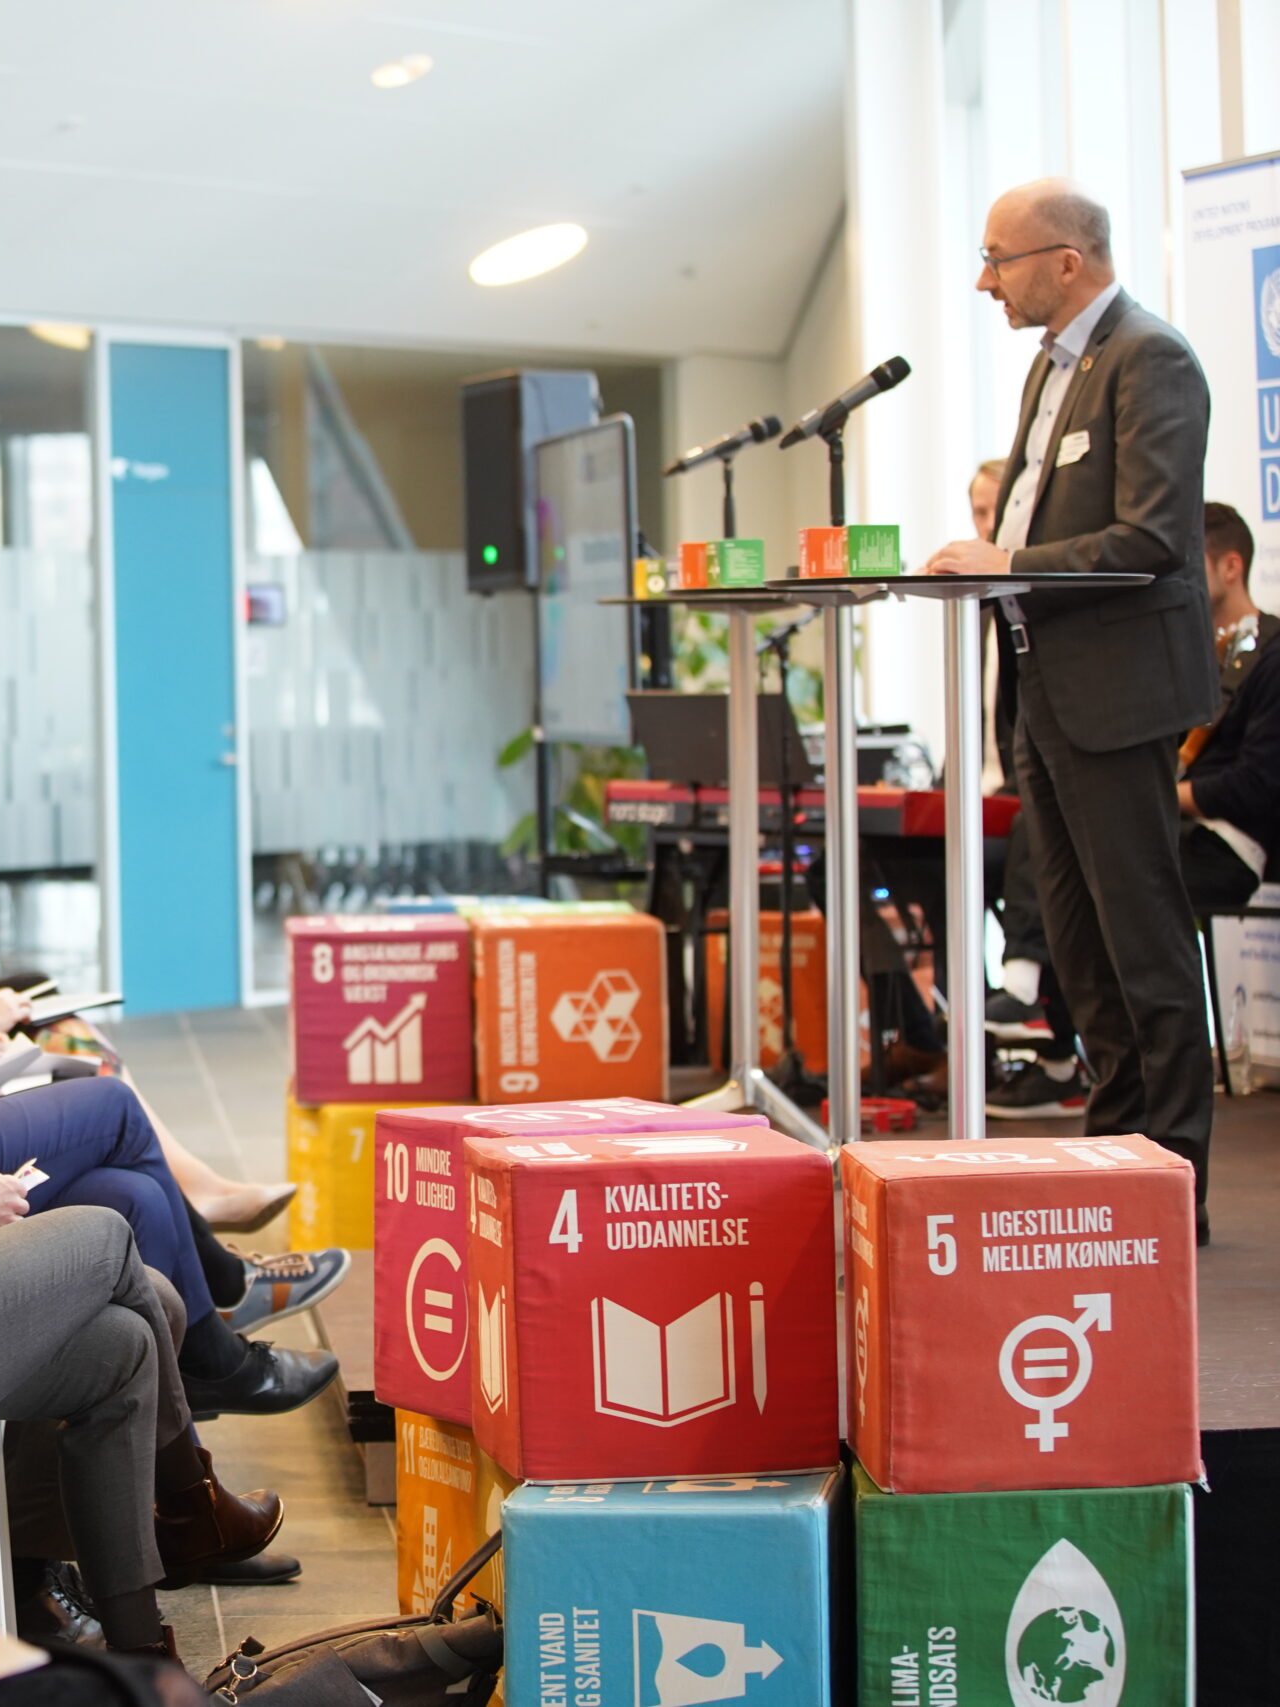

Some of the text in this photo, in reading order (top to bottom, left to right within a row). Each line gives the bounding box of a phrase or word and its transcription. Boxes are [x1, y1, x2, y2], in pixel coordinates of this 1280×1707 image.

[312, 942, 334, 983] 8
[424, 941, 459, 962] JOBS
[499, 1071, 540, 1093] 9
[348, 1127, 366, 1163] 7
[415, 1146, 451, 1177] MINDRE
[384, 1142, 408, 1204] 10
[416, 1180, 455, 1212] ULIGHED
[605, 1182, 729, 1213] KVALITETS-
[549, 1189, 583, 1253] 4
[606, 1218, 749, 1250] UDDANNELSE
[981, 1206, 1113, 1238] LIGESTILLING
[927, 1214, 957, 1276] 5
[983, 1238, 1160, 1273] MELLEM KØNNENE
[402, 1422, 415, 1475] 11
[538, 1612, 566, 1668] VAND
[572, 1606, 601, 1690] SANITET
[891, 1645, 920, 1707] LIMA-
